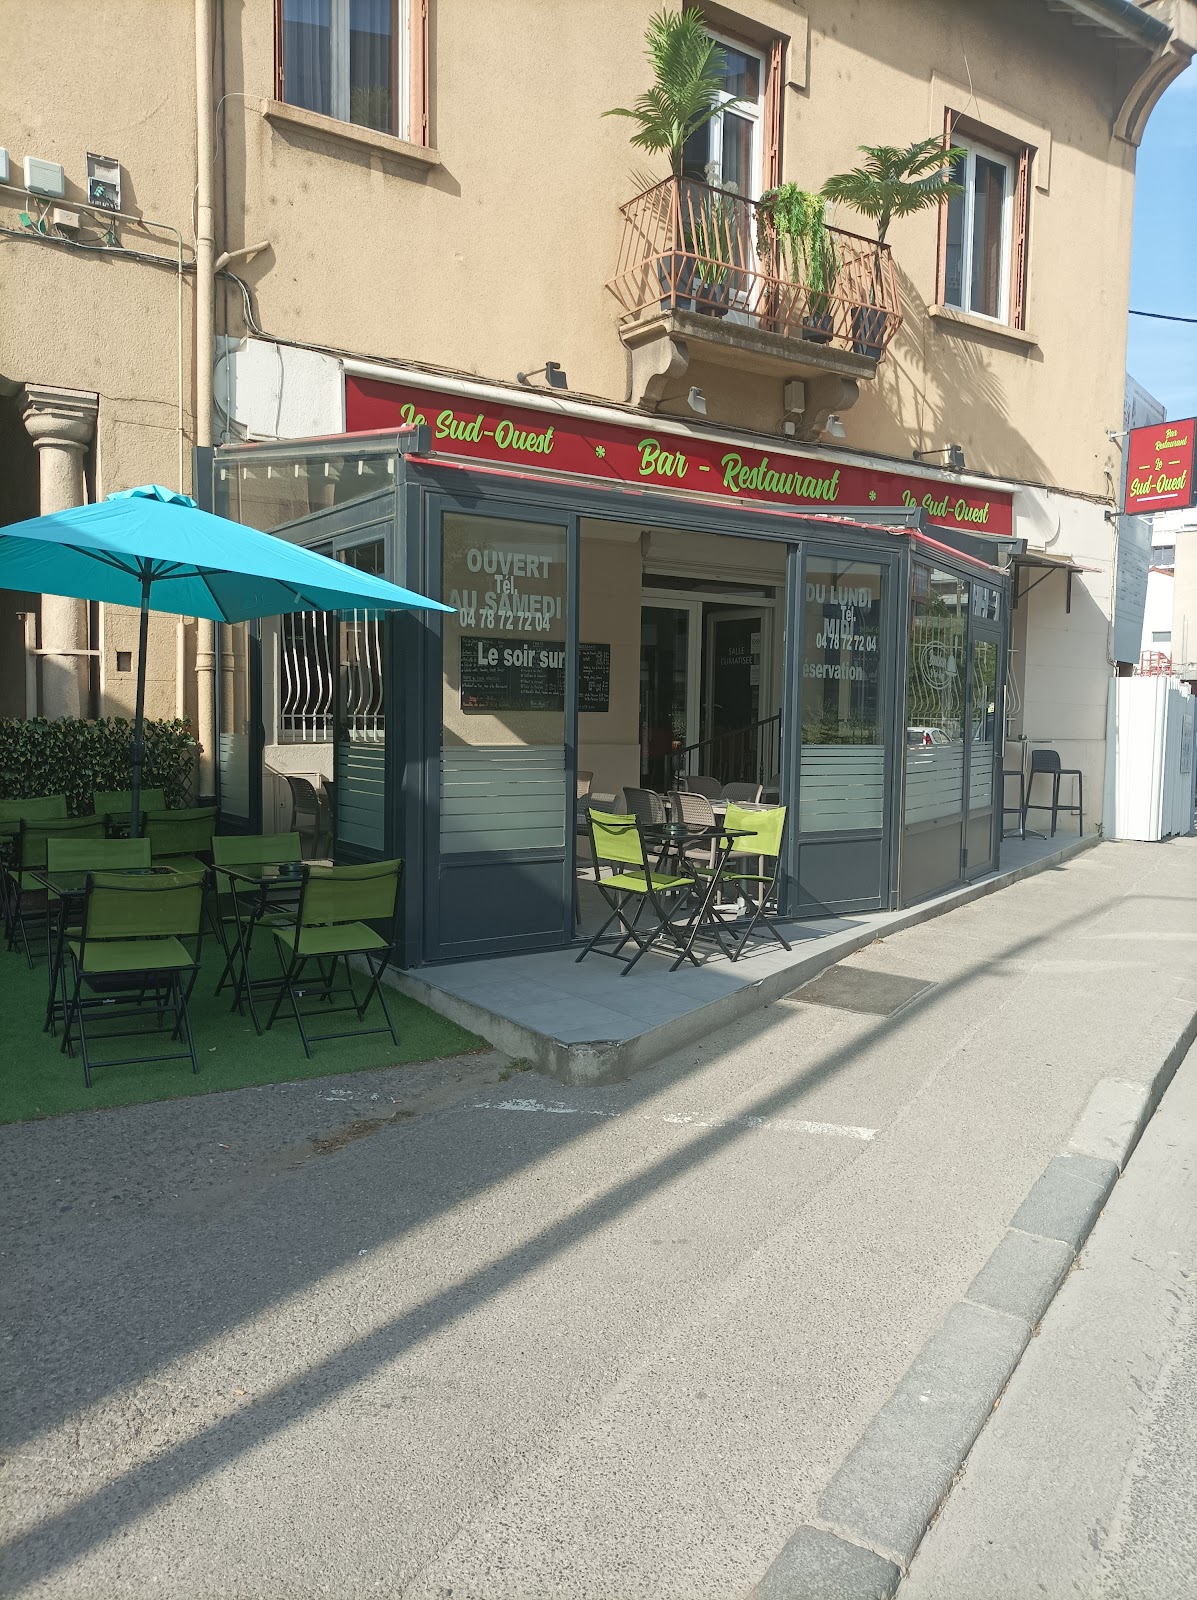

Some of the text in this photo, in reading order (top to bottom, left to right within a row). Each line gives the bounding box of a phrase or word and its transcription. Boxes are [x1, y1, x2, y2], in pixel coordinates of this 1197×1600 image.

[435, 409, 554, 454] Sud-Ouest
[1155, 435, 1188, 451] Restaurant
[1165, 428, 1179, 439] Bar
[638, 438, 689, 479] Bar
[721, 452, 841, 502] Restaurant
[1154, 457, 1163, 471] Le
[1129, 469, 1187, 497] Sud-Ouest
[921, 492, 990, 524] Sud-Ouest
[467, 548, 553, 579] OUVERT
[494, 574, 518, 595] Tél.
[805, 582, 872, 609] DU LUNDI
[449, 588, 562, 619] AU SAMEDI
[840, 605, 857, 622] Tél.
[459, 607, 551, 632] 04 78 72 72 04
[823, 617, 854, 639] MIDI
[728, 646, 745, 656] SALLE
[816, 632, 877, 652] 04 78 72 72 04
[477, 641, 499, 666] Le
[503, 643, 536, 667] soir
[540, 650, 566, 669] sur
